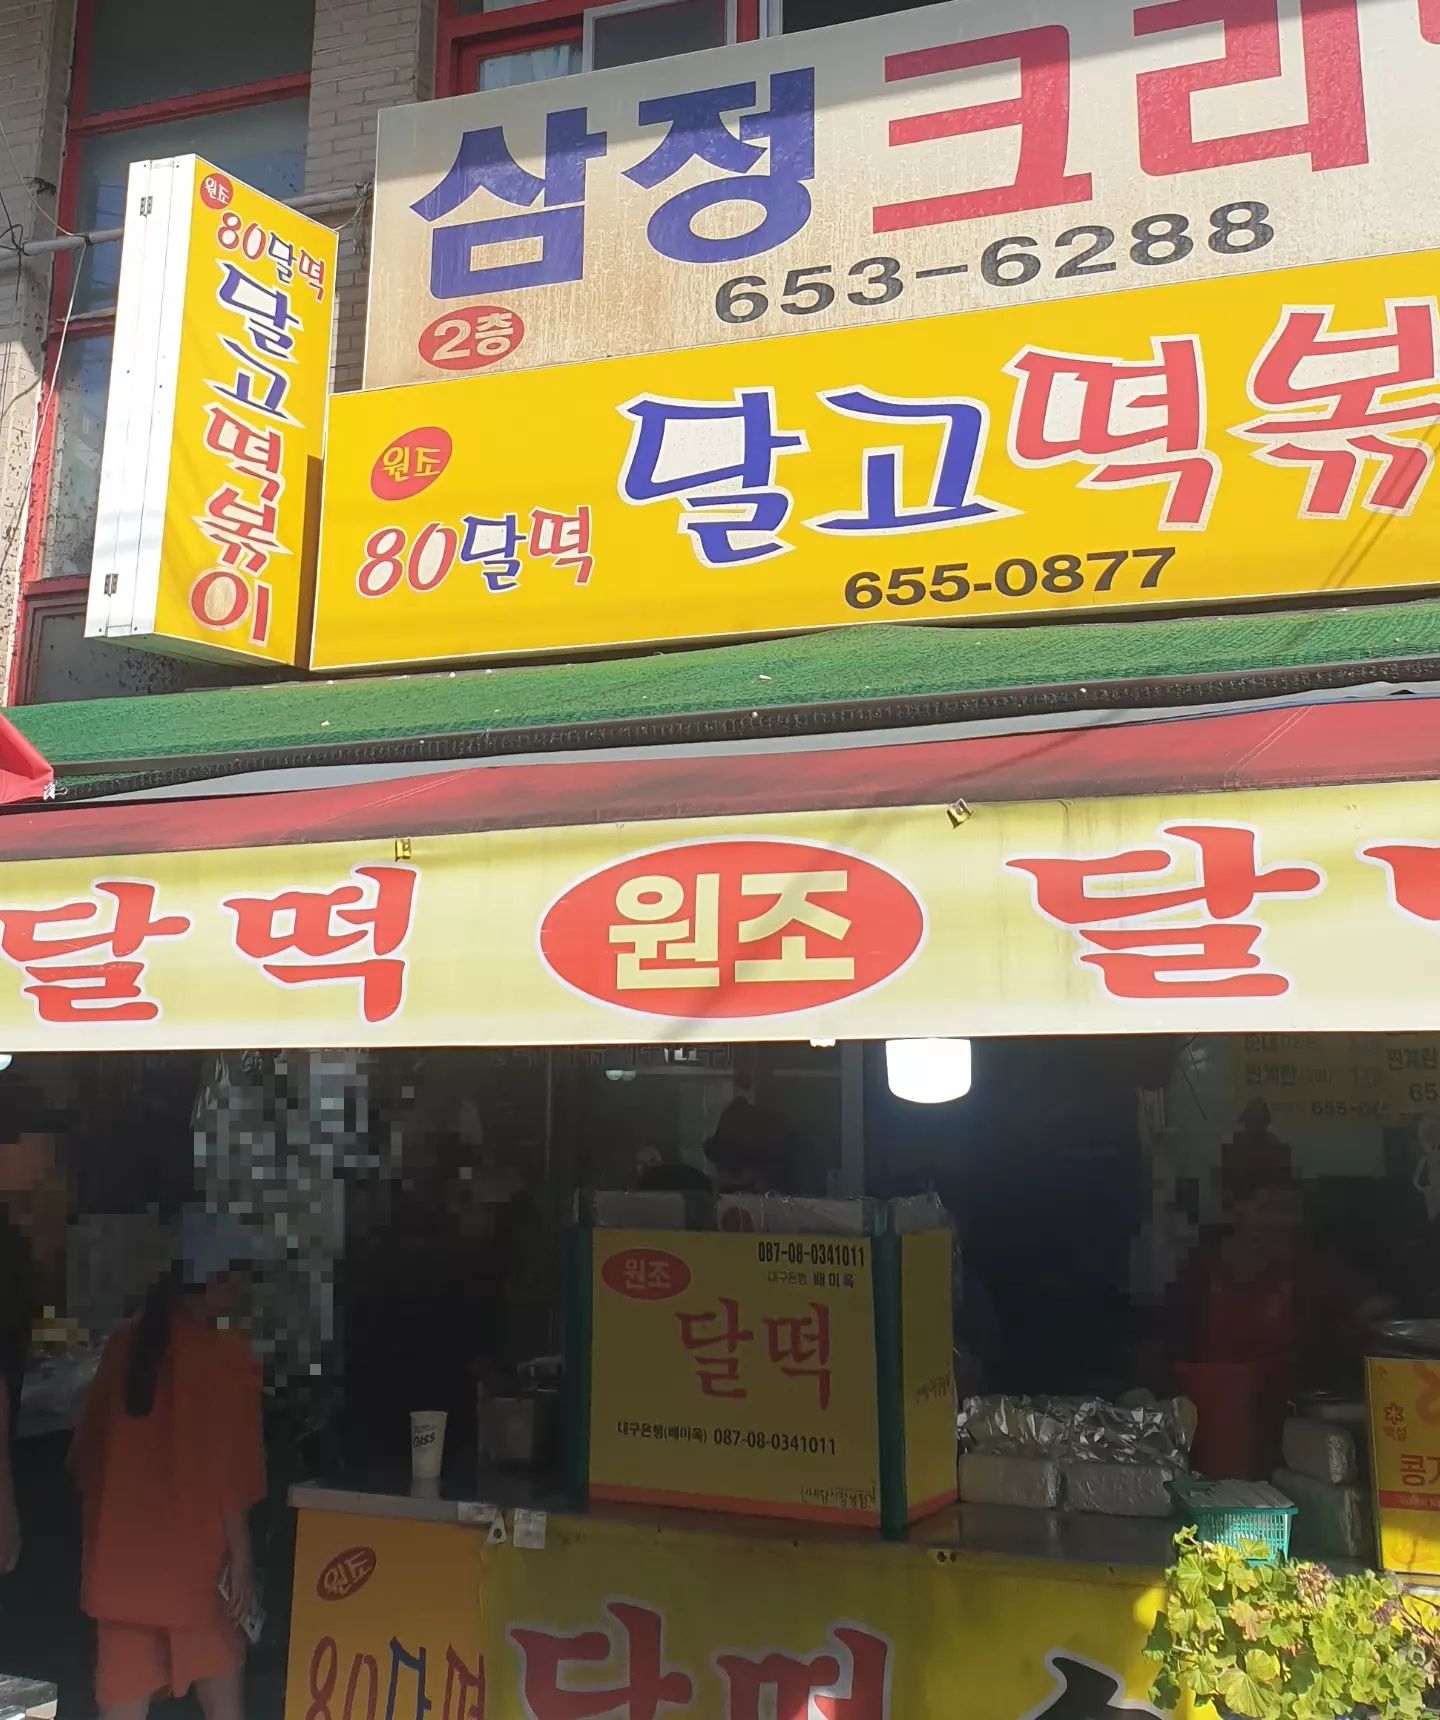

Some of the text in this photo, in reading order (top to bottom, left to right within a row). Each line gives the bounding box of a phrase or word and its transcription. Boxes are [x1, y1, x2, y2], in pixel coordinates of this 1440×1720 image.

[217, 211, 325, 302] 80달떡
[715, 201, 1274, 324] 653-6288
[432, 315, 518, 363] 2층
[189, 260, 305, 646] 달고떡볶이
[357, 504, 594, 597] 80달떡
[844, 547, 1177, 609] 655-0877
[607, 871, 856, 992] 원조
[623, 1258, 673, 1290] 원조
[758, 1241, 865, 1267] 087-08-0341011
[714, 1429, 836, 1455] 087-08-0341011
